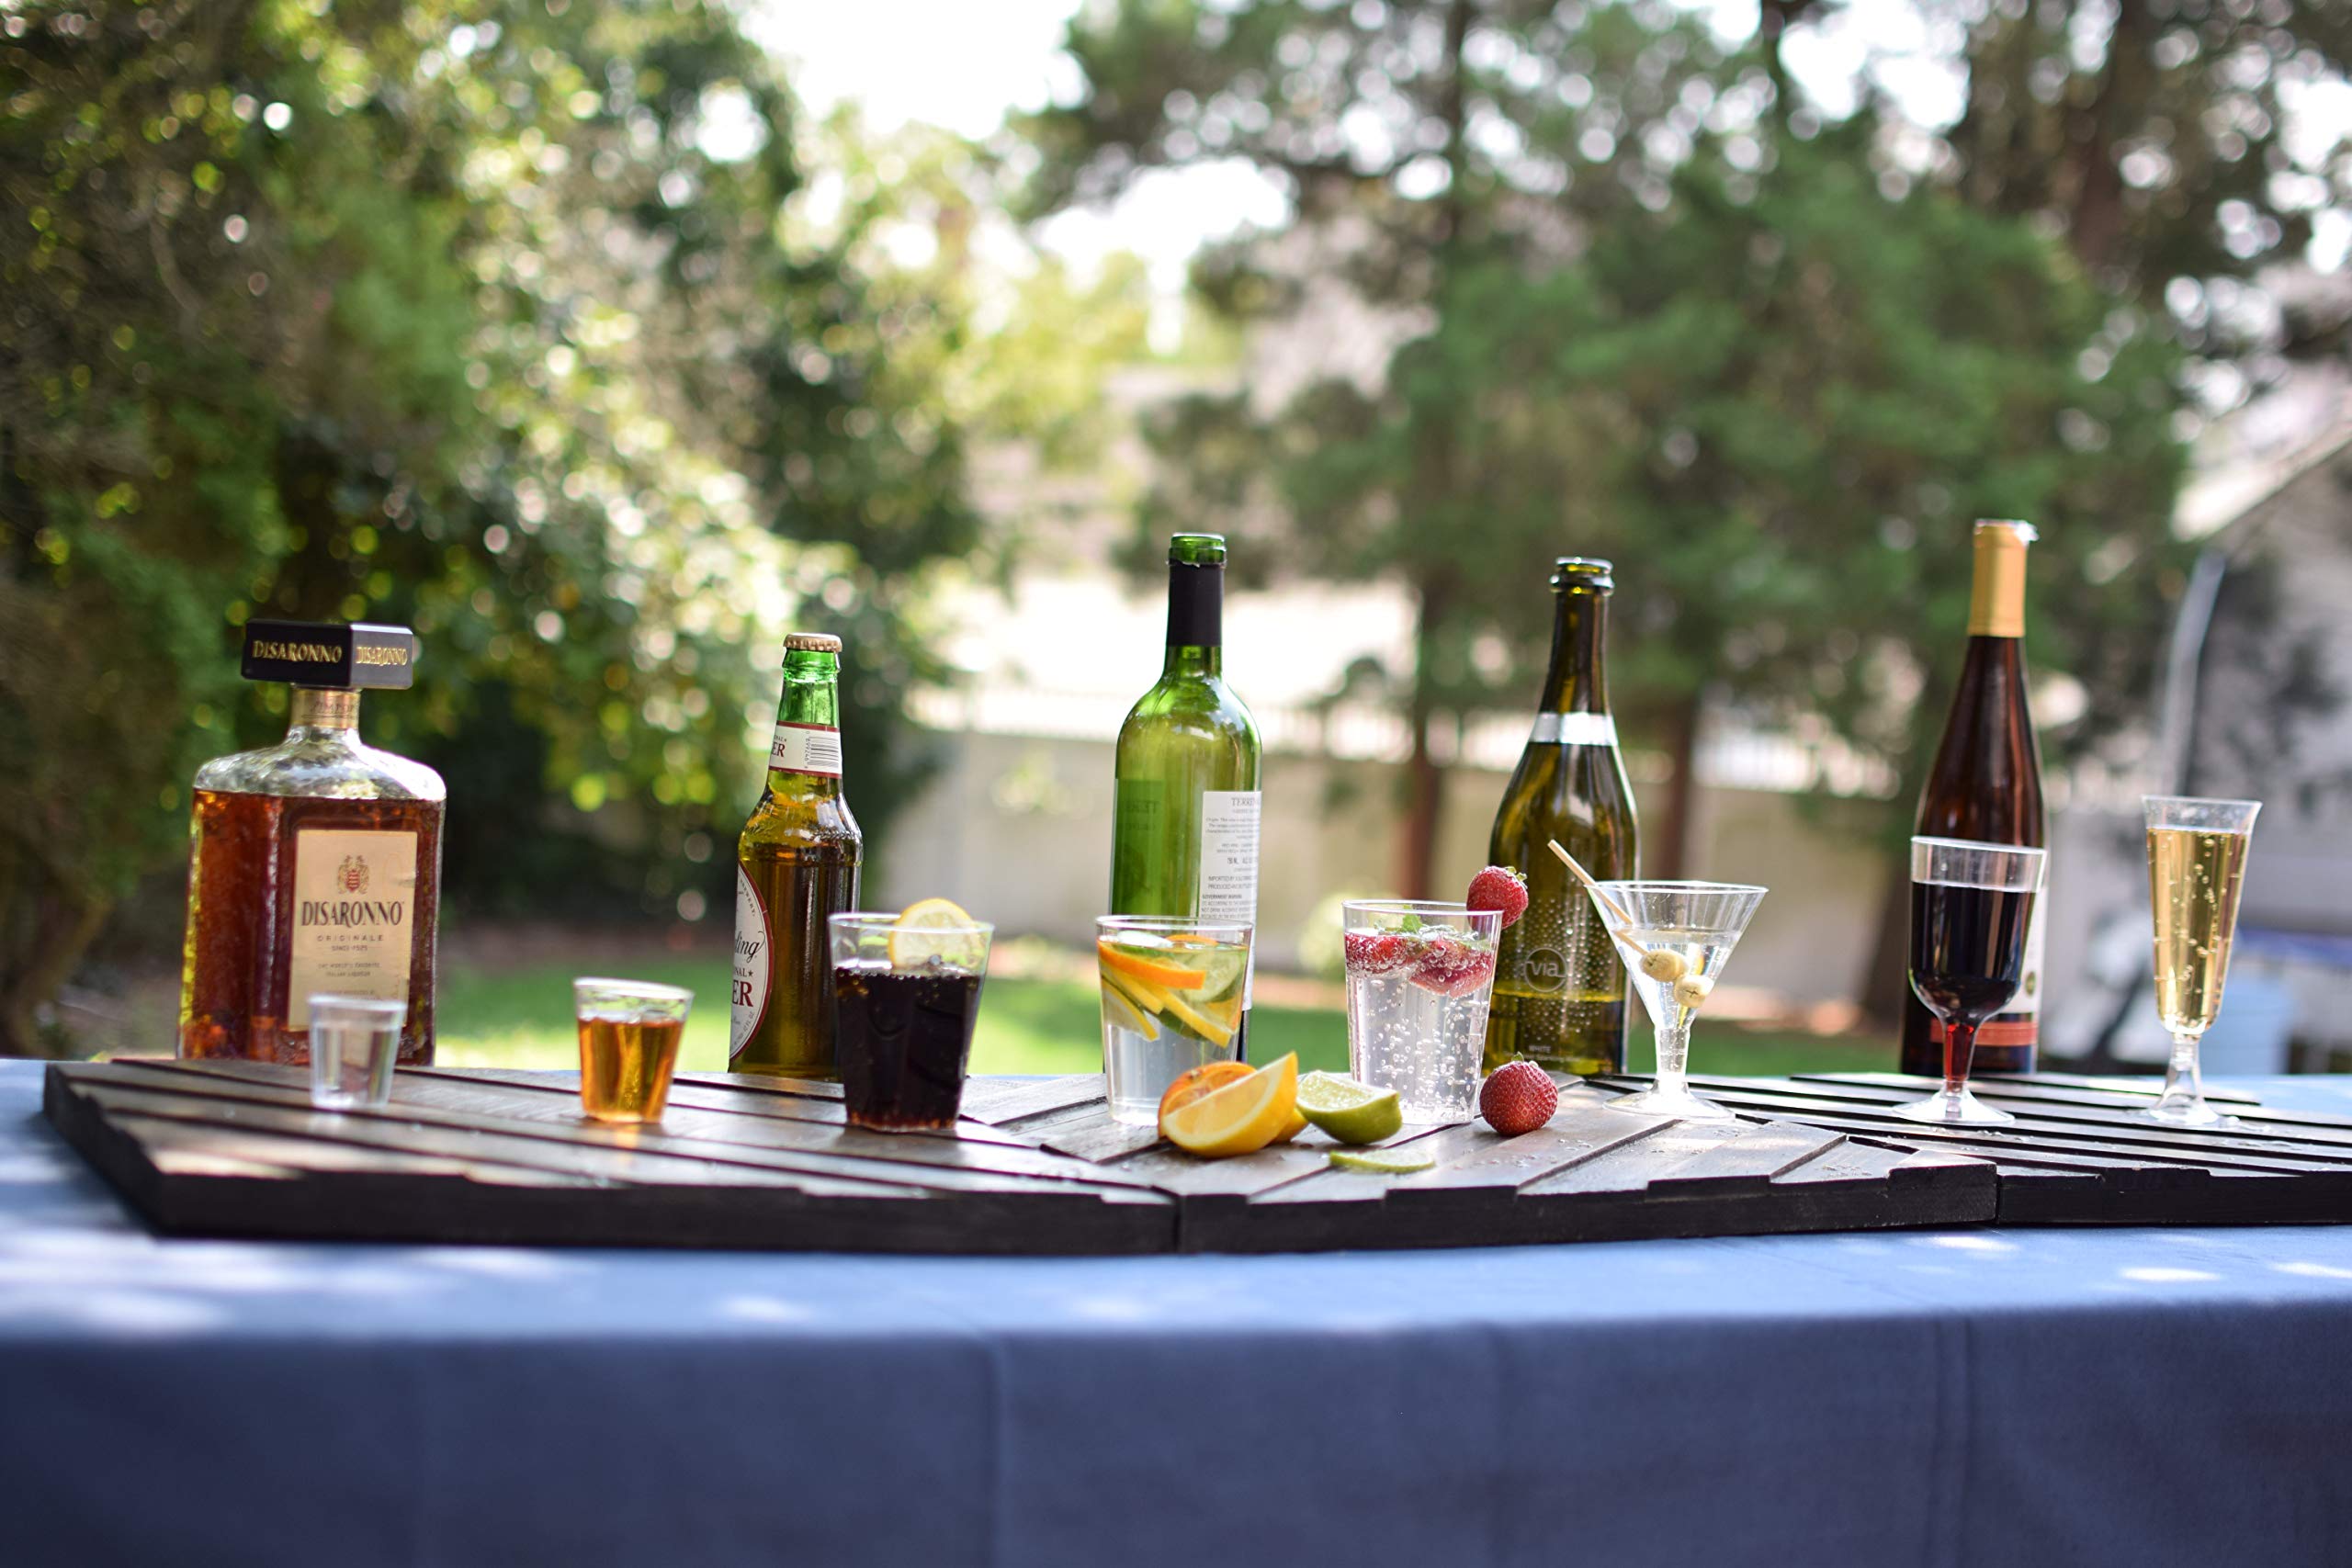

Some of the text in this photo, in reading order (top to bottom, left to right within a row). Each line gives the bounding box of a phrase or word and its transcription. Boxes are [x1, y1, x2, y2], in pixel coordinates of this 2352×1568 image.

[252, 639, 343, 663] DISARONNO
[356, 646, 408, 667] DISARONNO
[301, 901, 402, 929] DISARONNO
[316, 934, 384, 942] ORIGINALE
[1527, 960, 1564, 976] via
[731, 980, 754, 1008] ER
